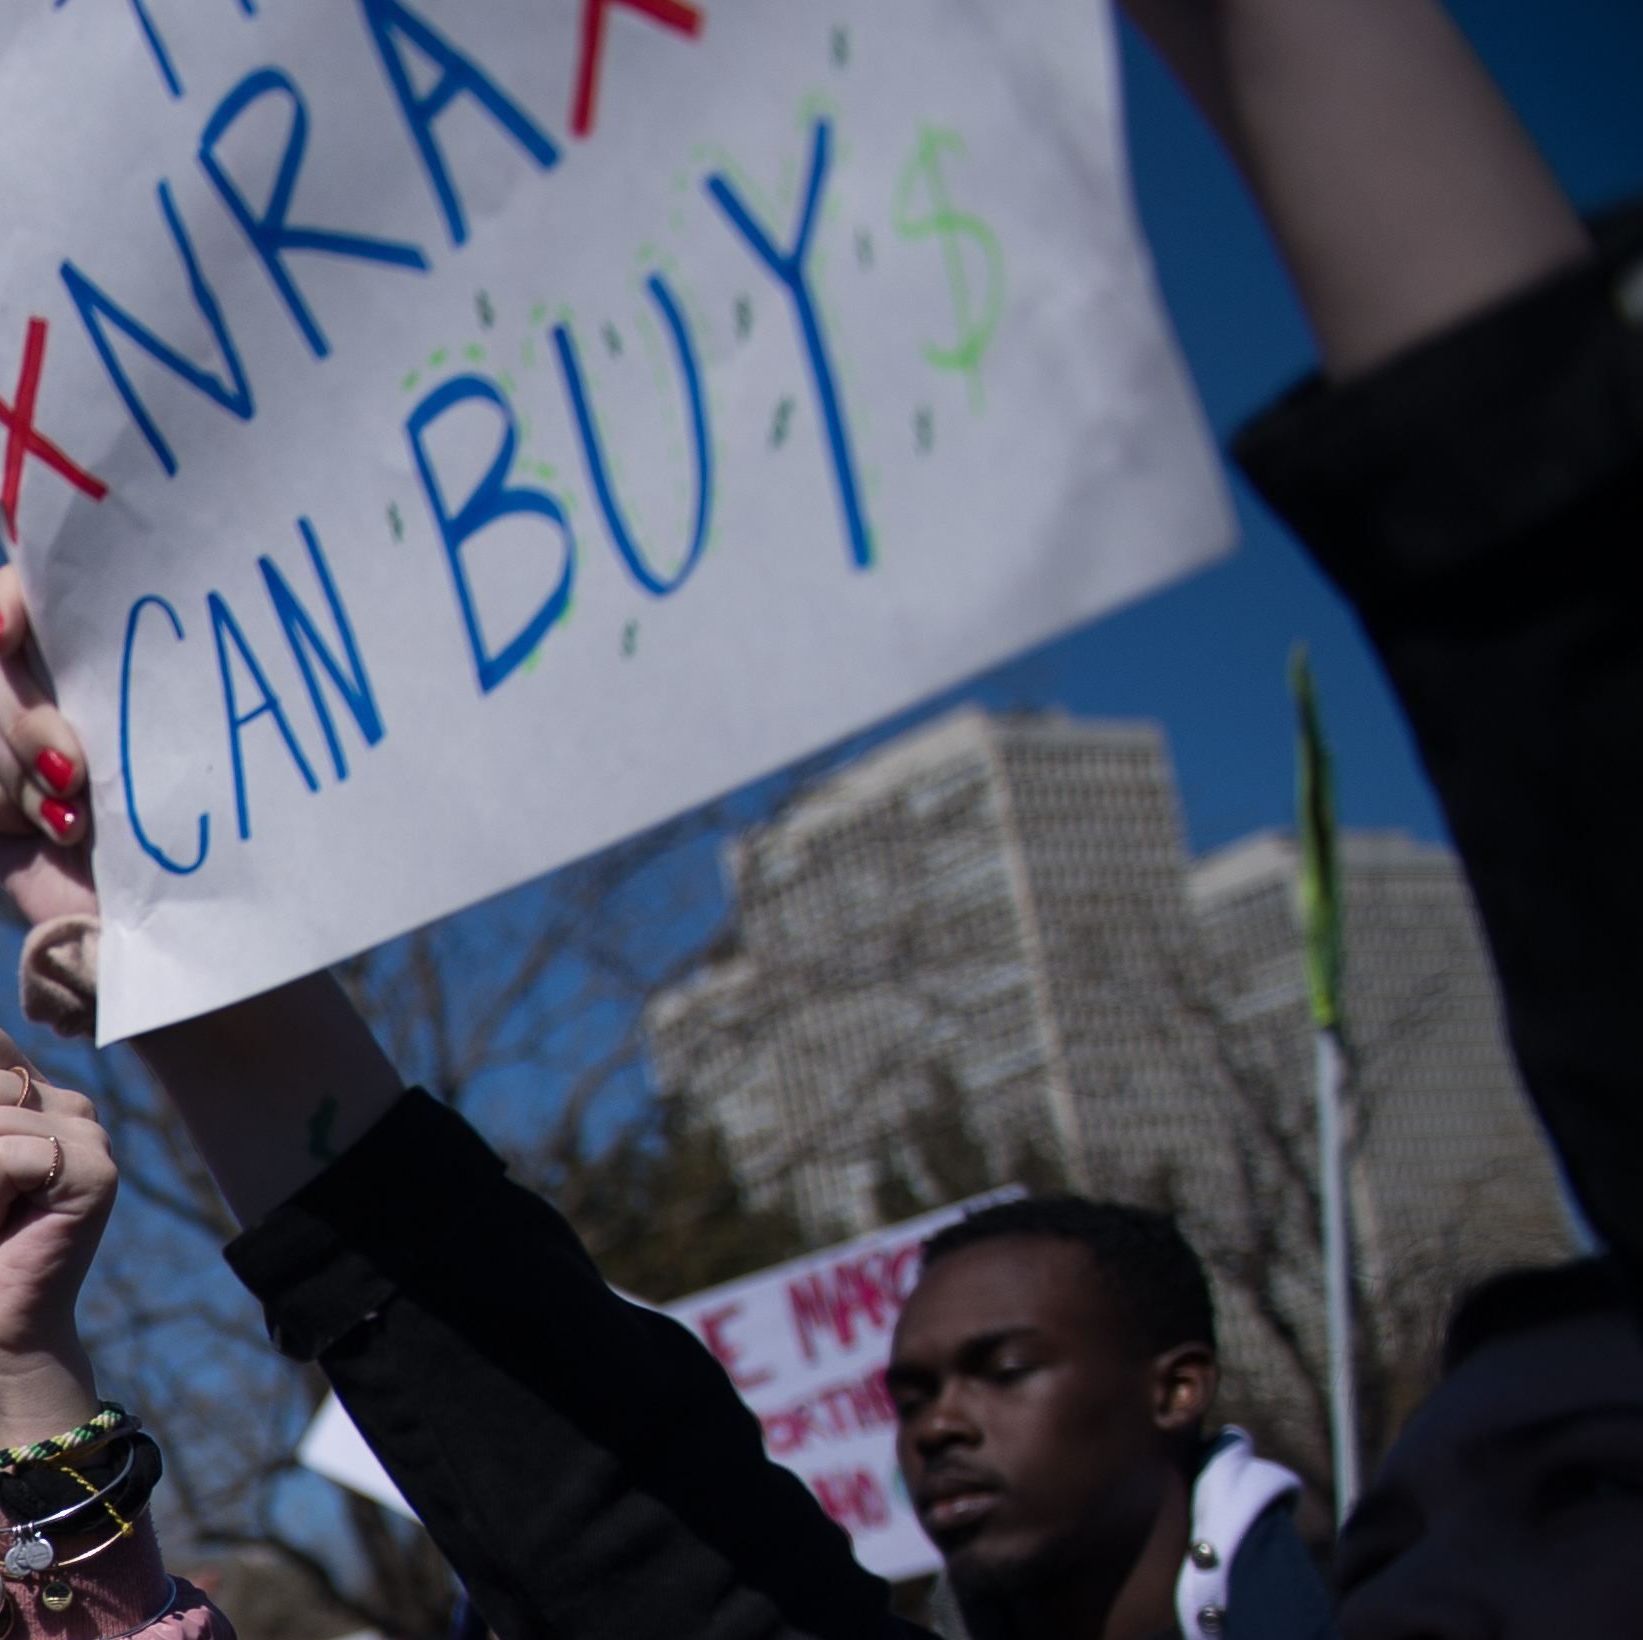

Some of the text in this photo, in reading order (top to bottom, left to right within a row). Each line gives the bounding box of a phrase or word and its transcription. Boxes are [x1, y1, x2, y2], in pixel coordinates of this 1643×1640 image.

[59, 0, 561, 479] NRA
[120, 517, 386, 876] CAN
[405, 115, 875, 694] BUY
